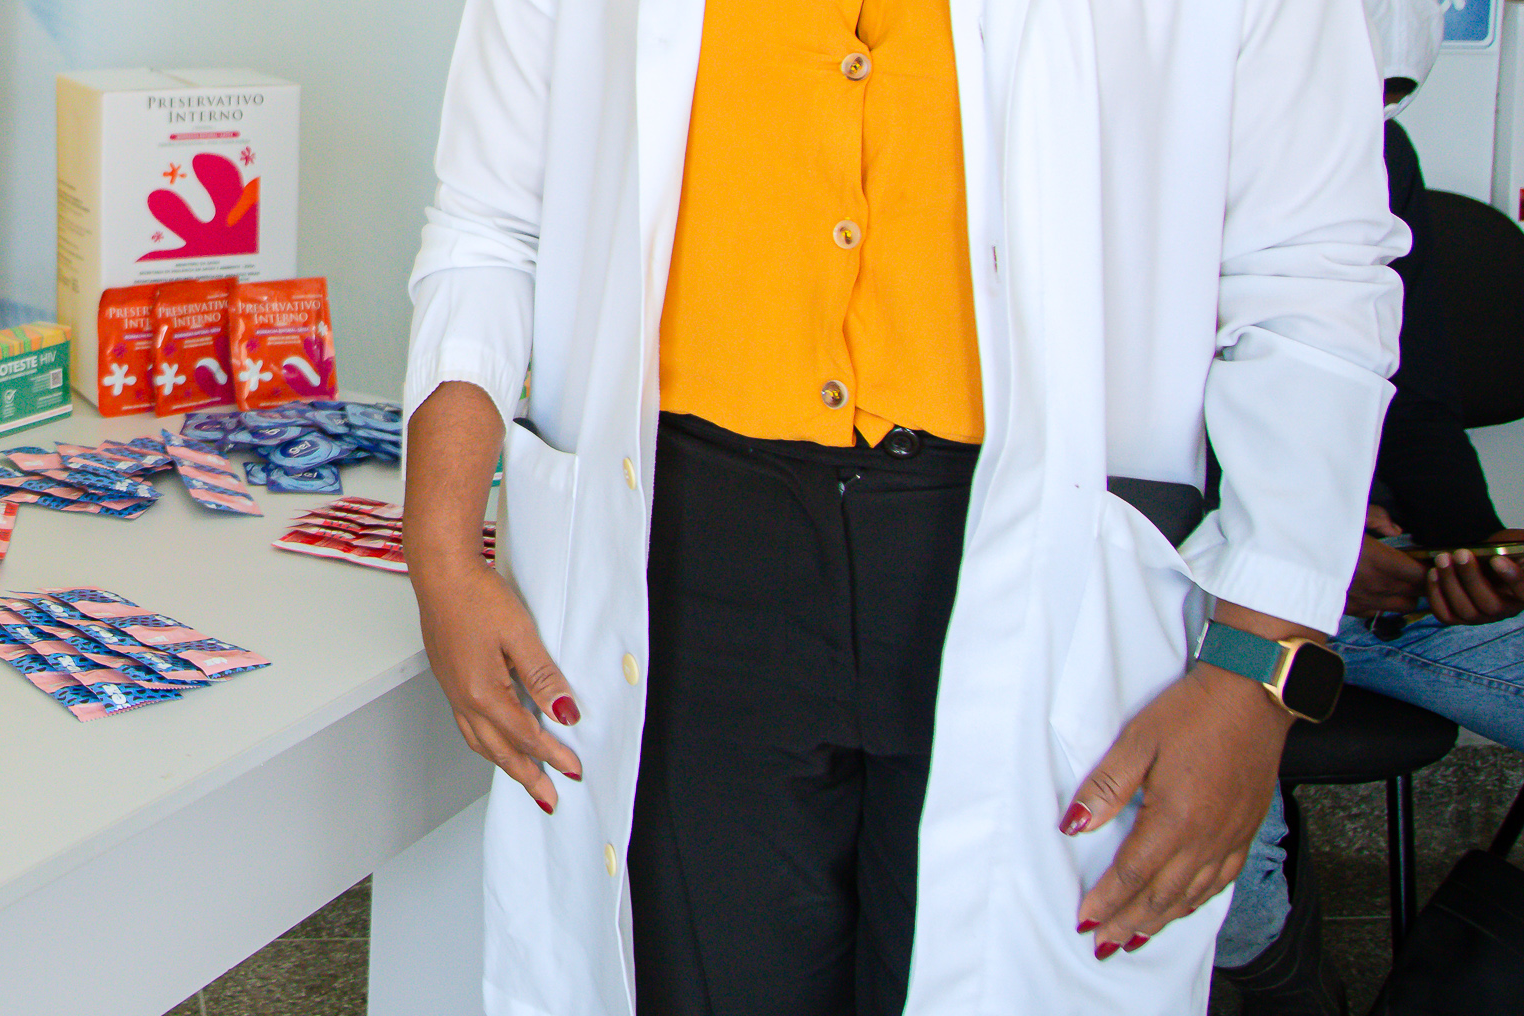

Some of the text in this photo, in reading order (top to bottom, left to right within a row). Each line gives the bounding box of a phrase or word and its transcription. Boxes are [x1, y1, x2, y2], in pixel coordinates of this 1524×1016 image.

[147, 93, 265, 110] PRESERVATIVO
[168, 109, 244, 123] INTERNO
[108, 305, 153, 319] PRESER
[238, 300, 321, 314] PRESERVATIVO
[173, 311, 221, 327] INTERNO
[254, 312, 308, 325] INTERNO
[39, 351, 57, 365] HIV
